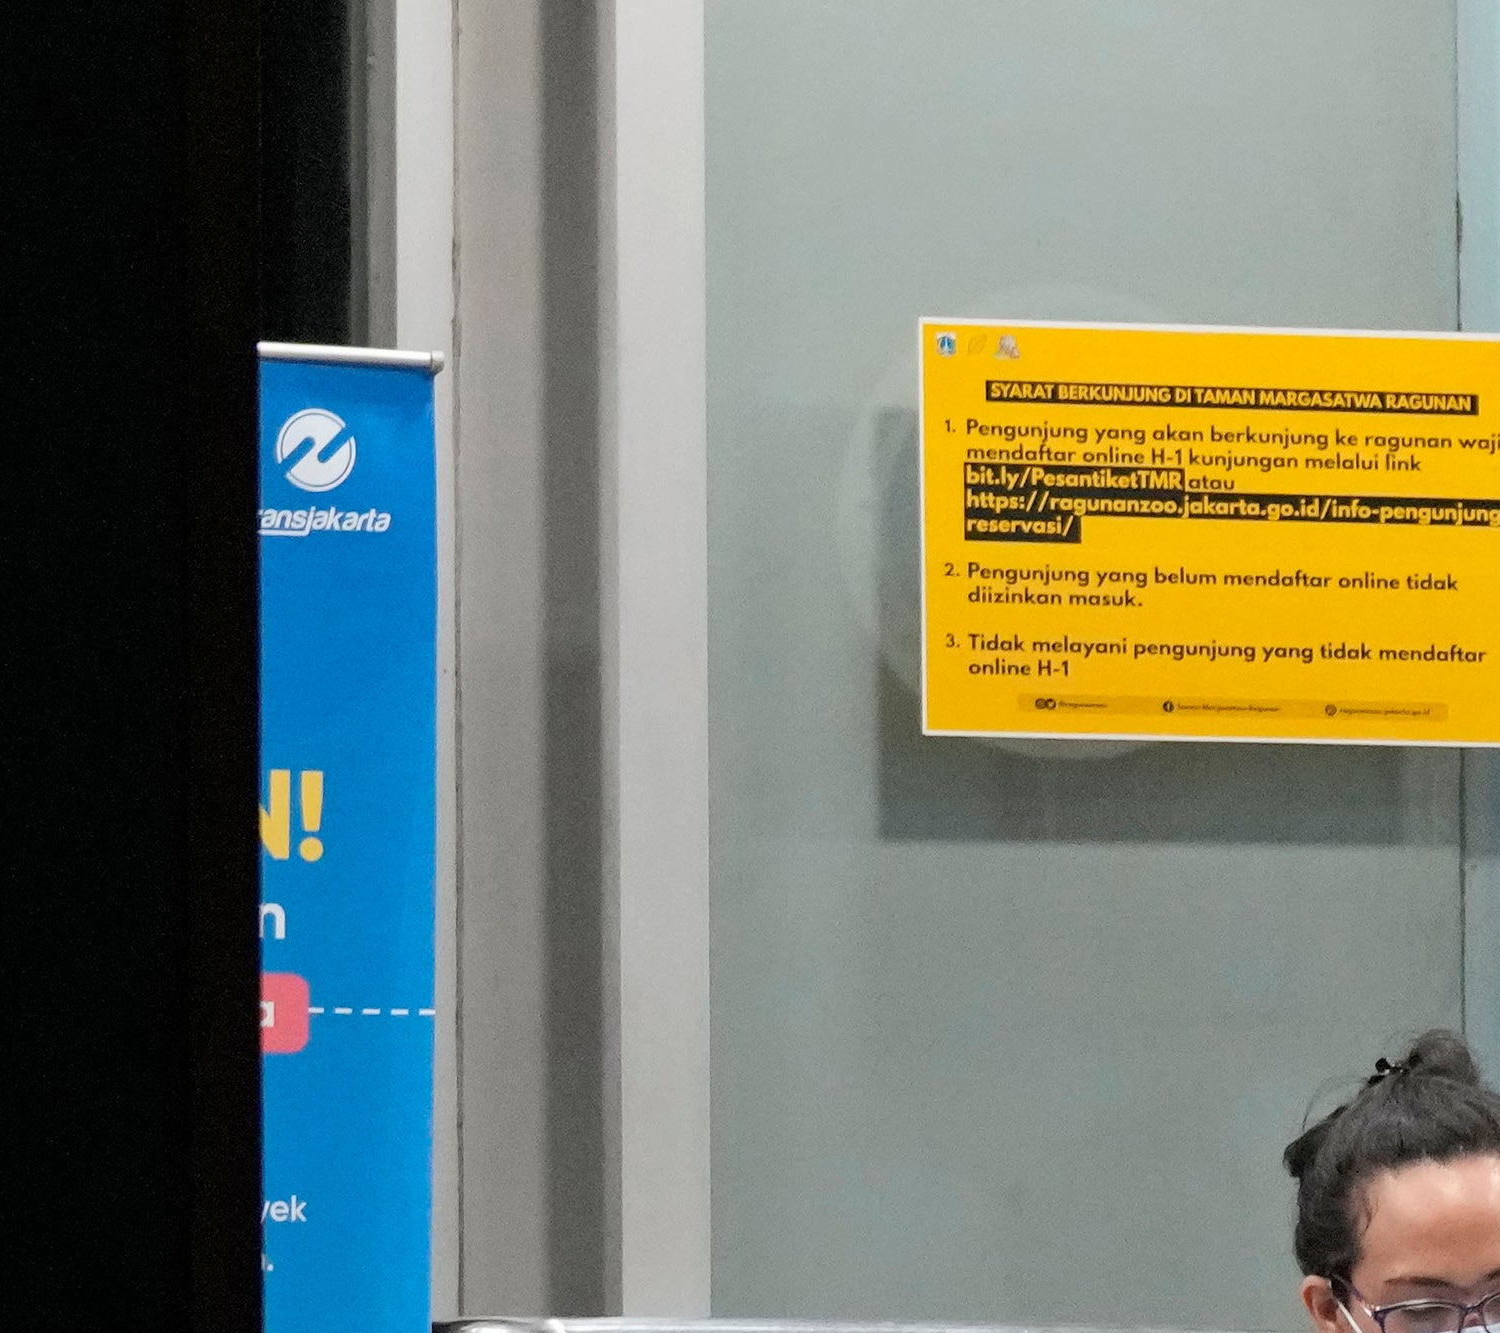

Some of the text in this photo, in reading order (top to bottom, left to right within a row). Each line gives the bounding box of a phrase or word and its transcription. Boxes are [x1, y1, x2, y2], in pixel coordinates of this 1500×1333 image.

[991, 383, 1472, 412] SYARAT BERKUNJUNG DI TAMAN MARGASATWA RAGUNAN
[945, 419, 956, 433] 1.
[966, 418, 1088, 442] Pengunjung
[1096, 428, 1147, 445] yang
[1152, 424, 1204, 442] akan
[1210, 425, 1329, 449] berkunjung
[1335, 428, 1359, 446] ke
[1365, 434, 1453, 452] ragunan
[966, 443, 1422, 472] mendaftar online H-1 kunjungan melalui link
[966, 465, 1235, 491] bit.ly/PesantiketTMR atau
[966, 514, 1074, 537] reservasi/
[944, 561, 1459, 592] 2. Pengunjung yang belum mendaftar online tidak
[967, 586, 1143, 608] diizinkan masuk.
[945, 633, 1487, 664] 3. Tidak melayani pengunjung yang tidak mendaftar
[968, 658, 1069, 677] online H-1
